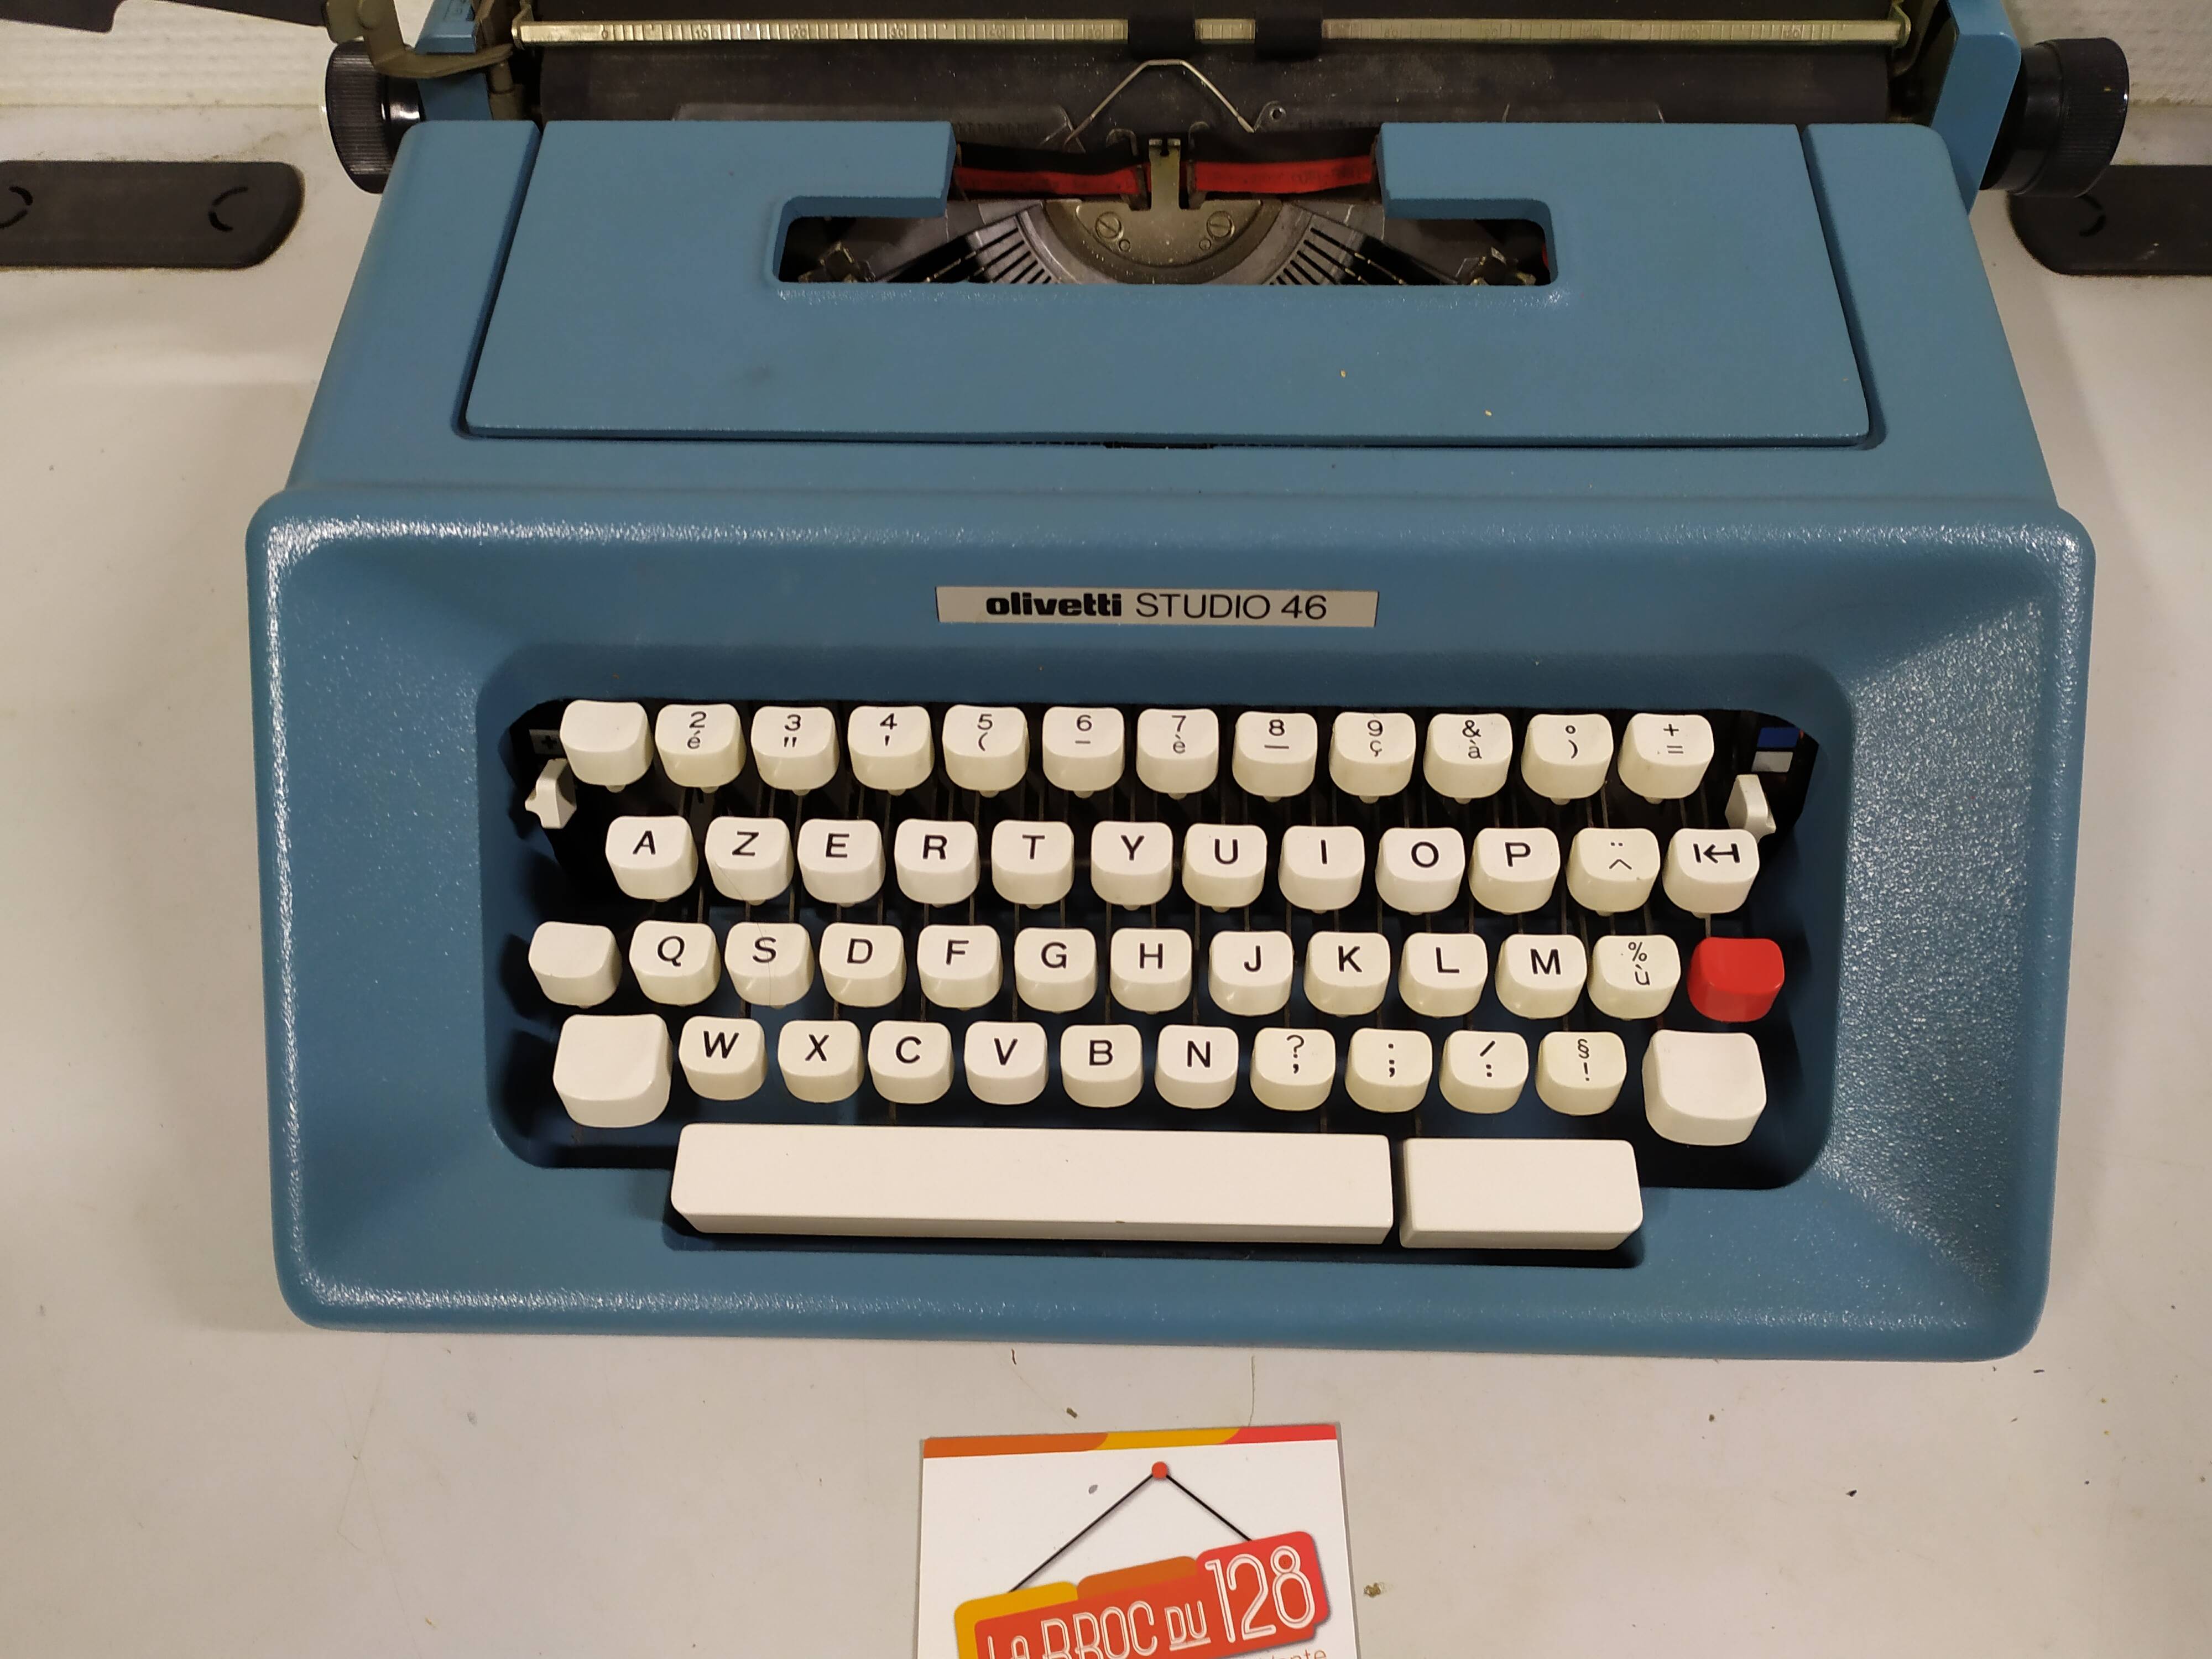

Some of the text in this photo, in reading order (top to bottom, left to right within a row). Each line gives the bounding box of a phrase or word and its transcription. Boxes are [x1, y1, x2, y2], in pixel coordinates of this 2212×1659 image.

[695, 29, 708, 39] 10
[986, 592, 1327, 620] olivetti STUDIO 46
[689, 711, 707, 728] 2
[784, 714, 801, 731] 3
[880, 713, 898, 730] 4
[977, 714, 993, 730] 5
[1076, 714, 1092, 732] 6
[1172, 715, 1186, 732] 7
[1269, 719, 1285, 736] 8
[1367, 719, 1383, 737] 9
[1462, 719, 1481, 738] &
[1663, 723, 1679, 737] +
[687, 730, 701, 749] é
[1172, 734, 1186, 754] è
[1370, 740, 1383, 757] ç
[1468, 739, 1482, 759] à
[1666, 745, 1684, 754] =
[633, 830, 656, 855] A
[732, 831, 759, 857] Z
[825, 833, 850, 858] E
[922, 834, 947, 860] R
[1022, 834, 1045, 859] T
[1121, 835, 1145, 860] Y
[1214, 838, 1238, 865] U
[1321, 839, 1328, 864] I
[1411, 841, 1439, 868] O
[1505, 842, 1531, 867] P
[657, 936, 685, 967] Q
[753, 937, 776, 963] S
[847, 938, 873, 964] D
[946, 940, 969, 965] F
[1041, 942, 1067, 969] G
[1139, 943, 1163, 969] H
[1244, 945, 1261, 972] J
[1338, 946, 1362, 973] K
[1436, 947, 1460, 973] L
[1530, 948, 1561, 975] M
[1627, 941, 1647, 962] %
[1635, 964, 1650, 985] ù
[703, 1031, 739, 1059] W
[805, 1034, 830, 1062] X
[895, 1036, 922, 1064] C
[994, 1038, 1018, 1066] V
[1089, 1040, 1113, 1066] B
[1187, 1040, 1211, 1068] N
[1286, 1035, 1305, 1058] ?
[1577, 1039, 1589, 1059] §
[1164, 1600, 1208, 1644] DU
[1204, 1545, 1316, 1644] 128
